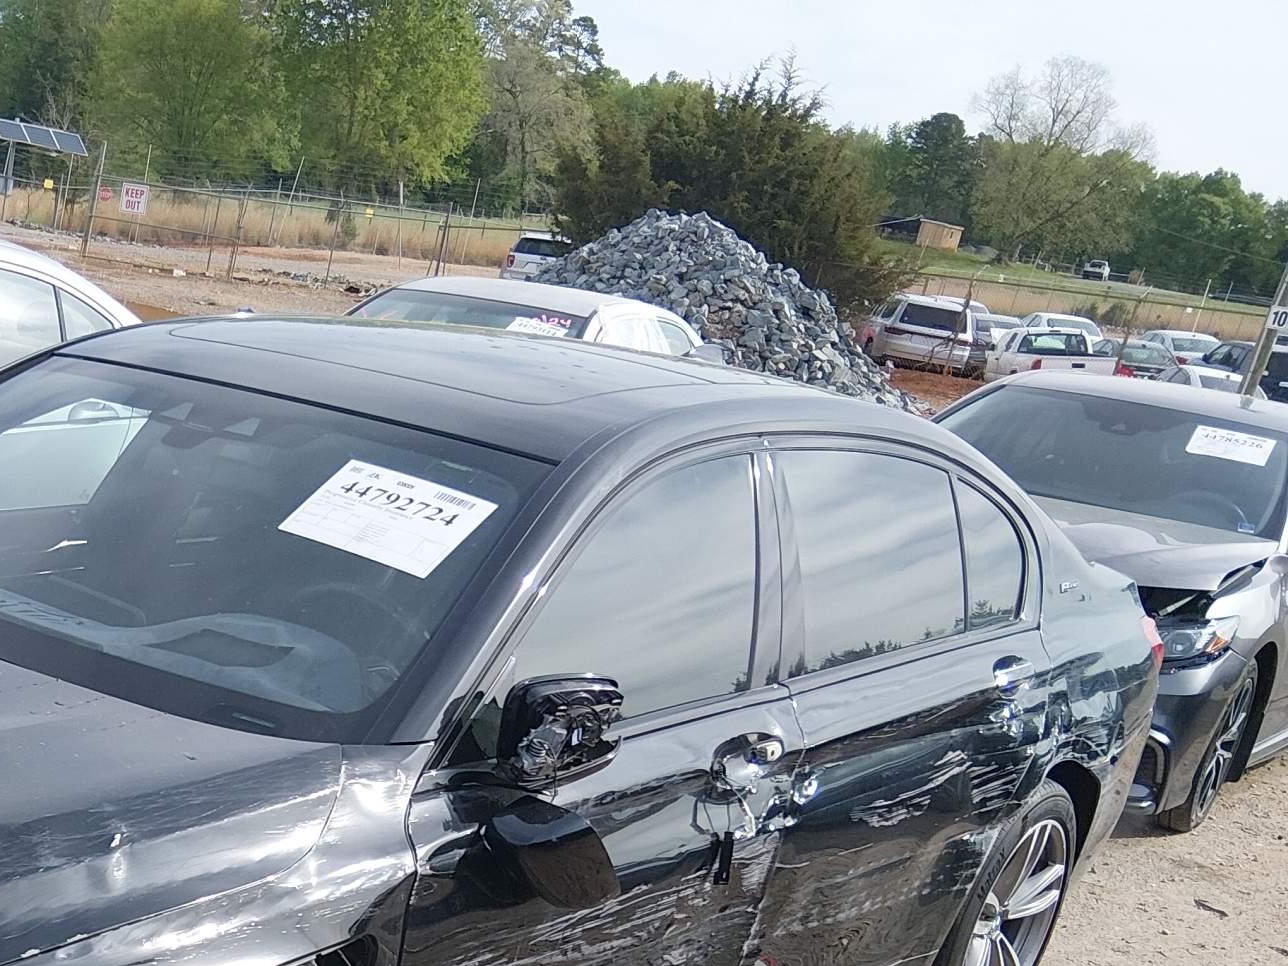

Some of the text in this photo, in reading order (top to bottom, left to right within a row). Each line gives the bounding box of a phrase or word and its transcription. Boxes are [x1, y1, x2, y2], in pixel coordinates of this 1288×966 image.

[124, 187, 145, 199] KEEP
[125, 199, 141, 211] OUT
[340, 481, 461, 527] 44792724
